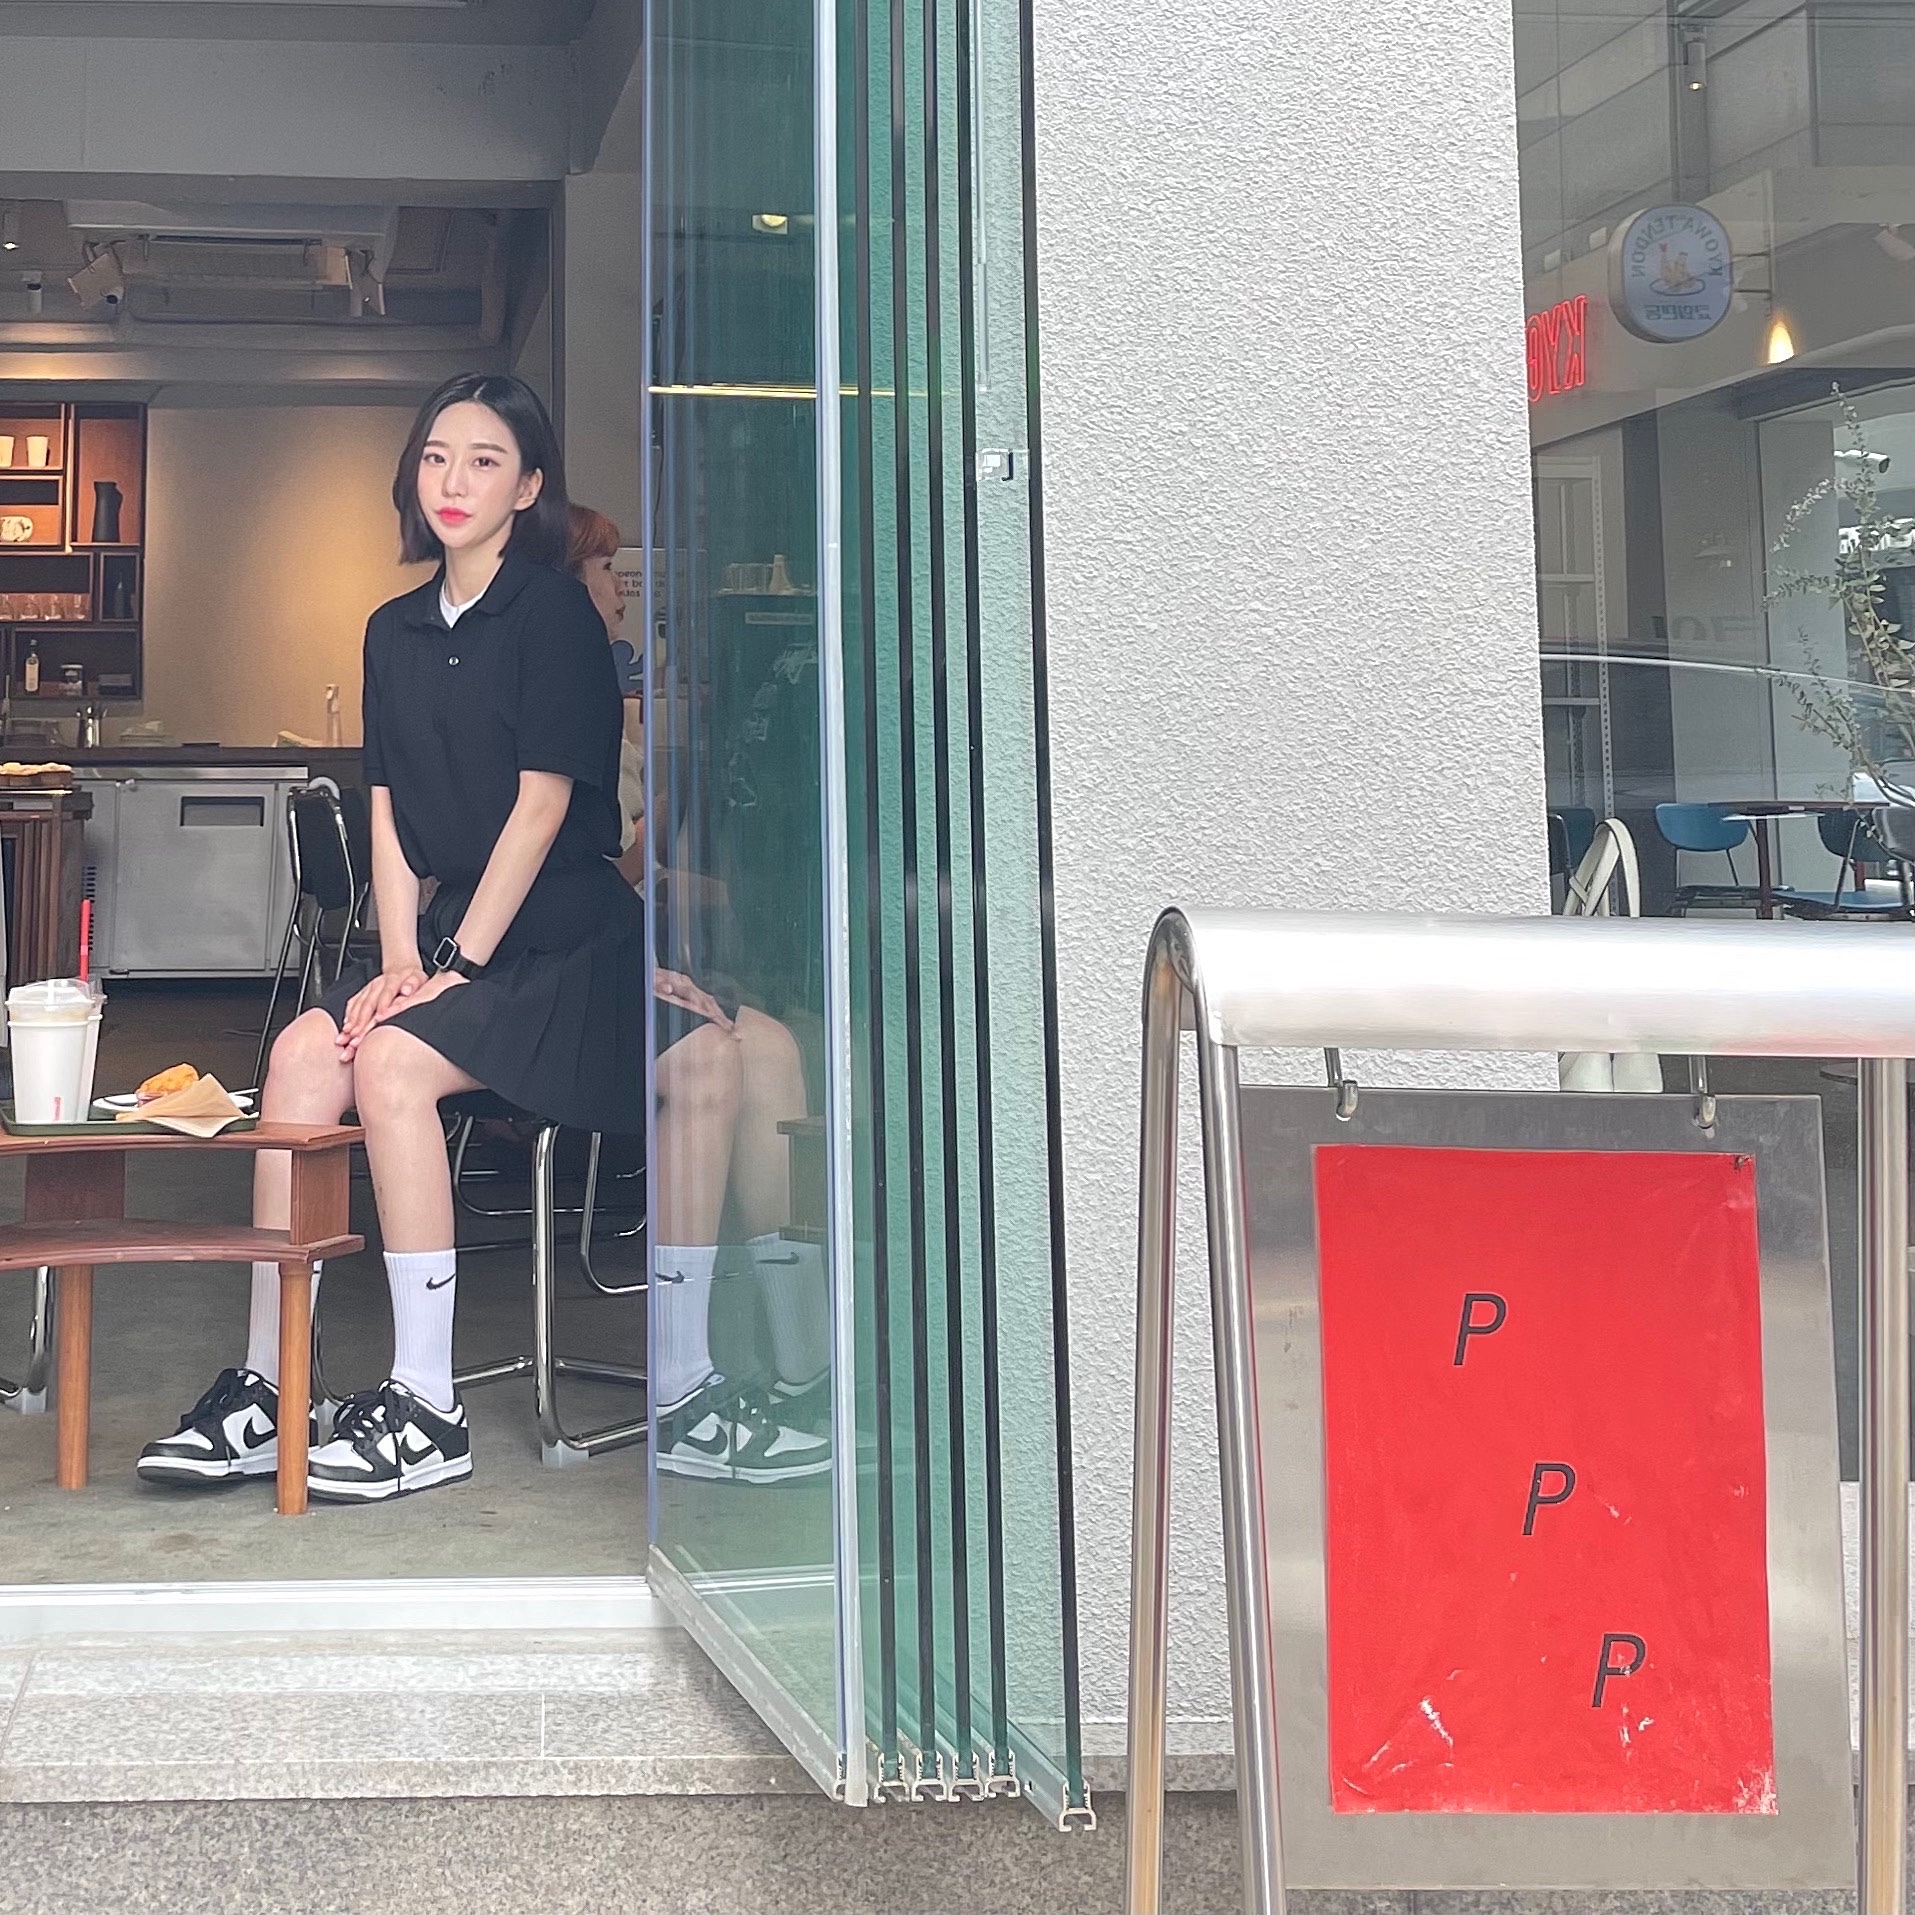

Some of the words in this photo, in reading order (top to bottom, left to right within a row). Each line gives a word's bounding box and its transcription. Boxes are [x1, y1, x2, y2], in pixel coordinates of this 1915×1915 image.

[1453, 1292, 1508, 1367] P
[1521, 1461, 1577, 1536] P
[1591, 1632, 1648, 1709] P
